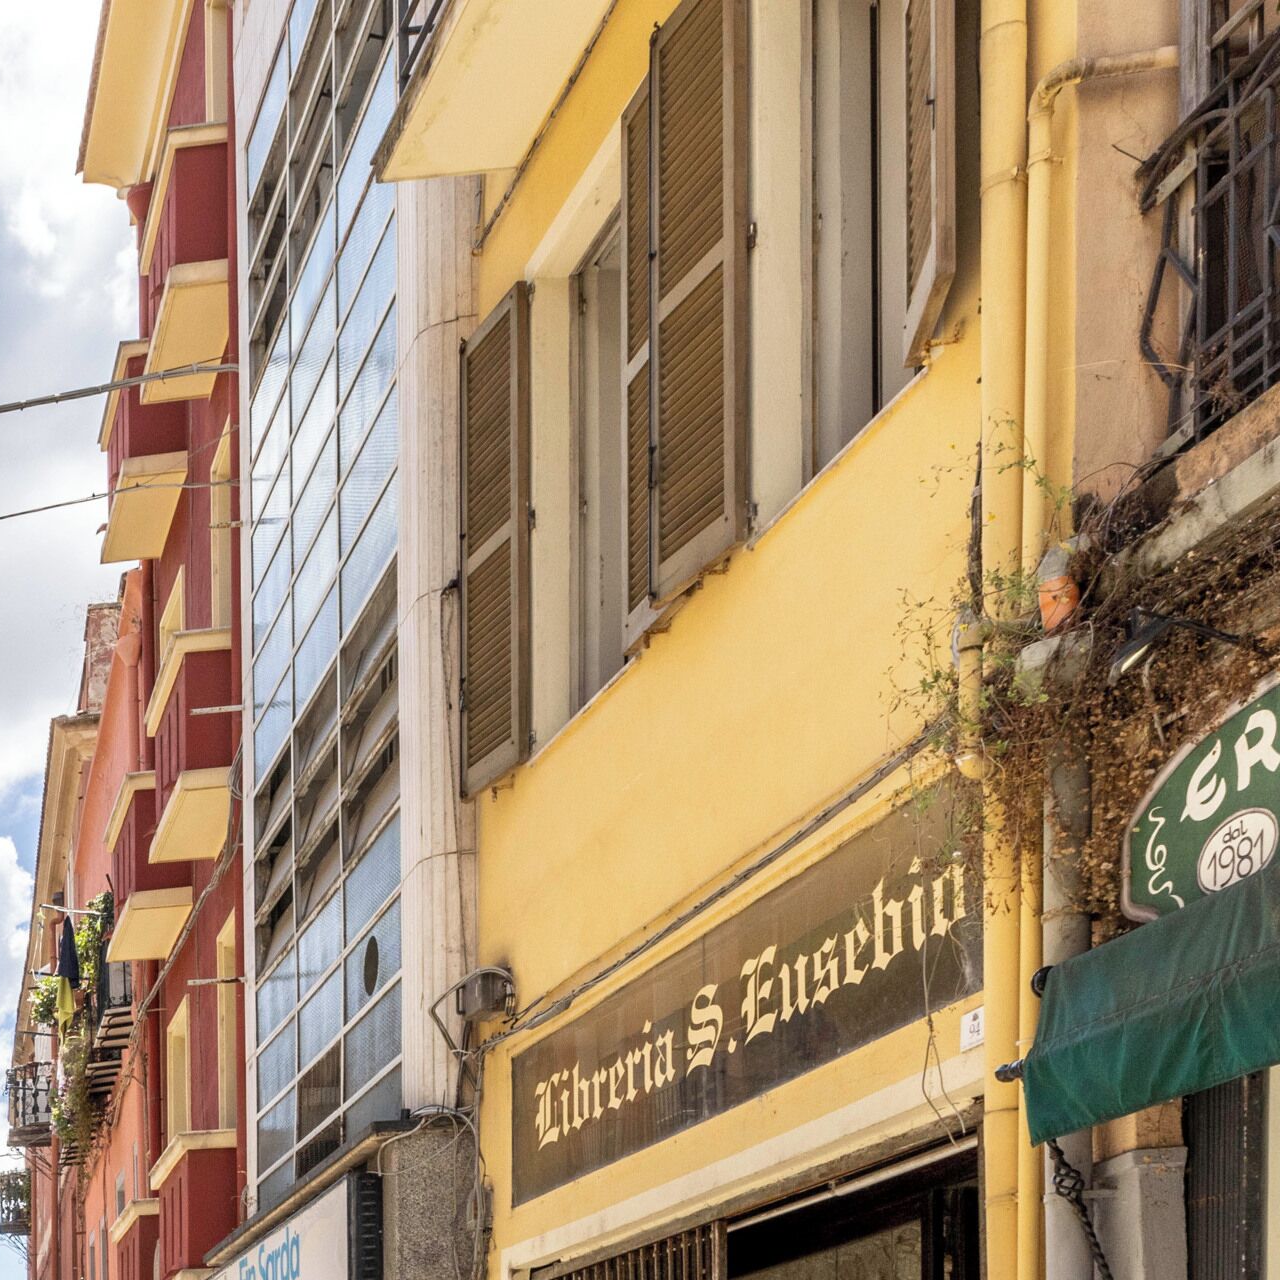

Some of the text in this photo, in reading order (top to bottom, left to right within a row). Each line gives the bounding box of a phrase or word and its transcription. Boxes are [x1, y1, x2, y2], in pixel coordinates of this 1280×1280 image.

[1207, 829, 1266, 888] 1981
[1223, 820, 1248, 844] dal
[535, 1019, 676, 1150] Libreria
